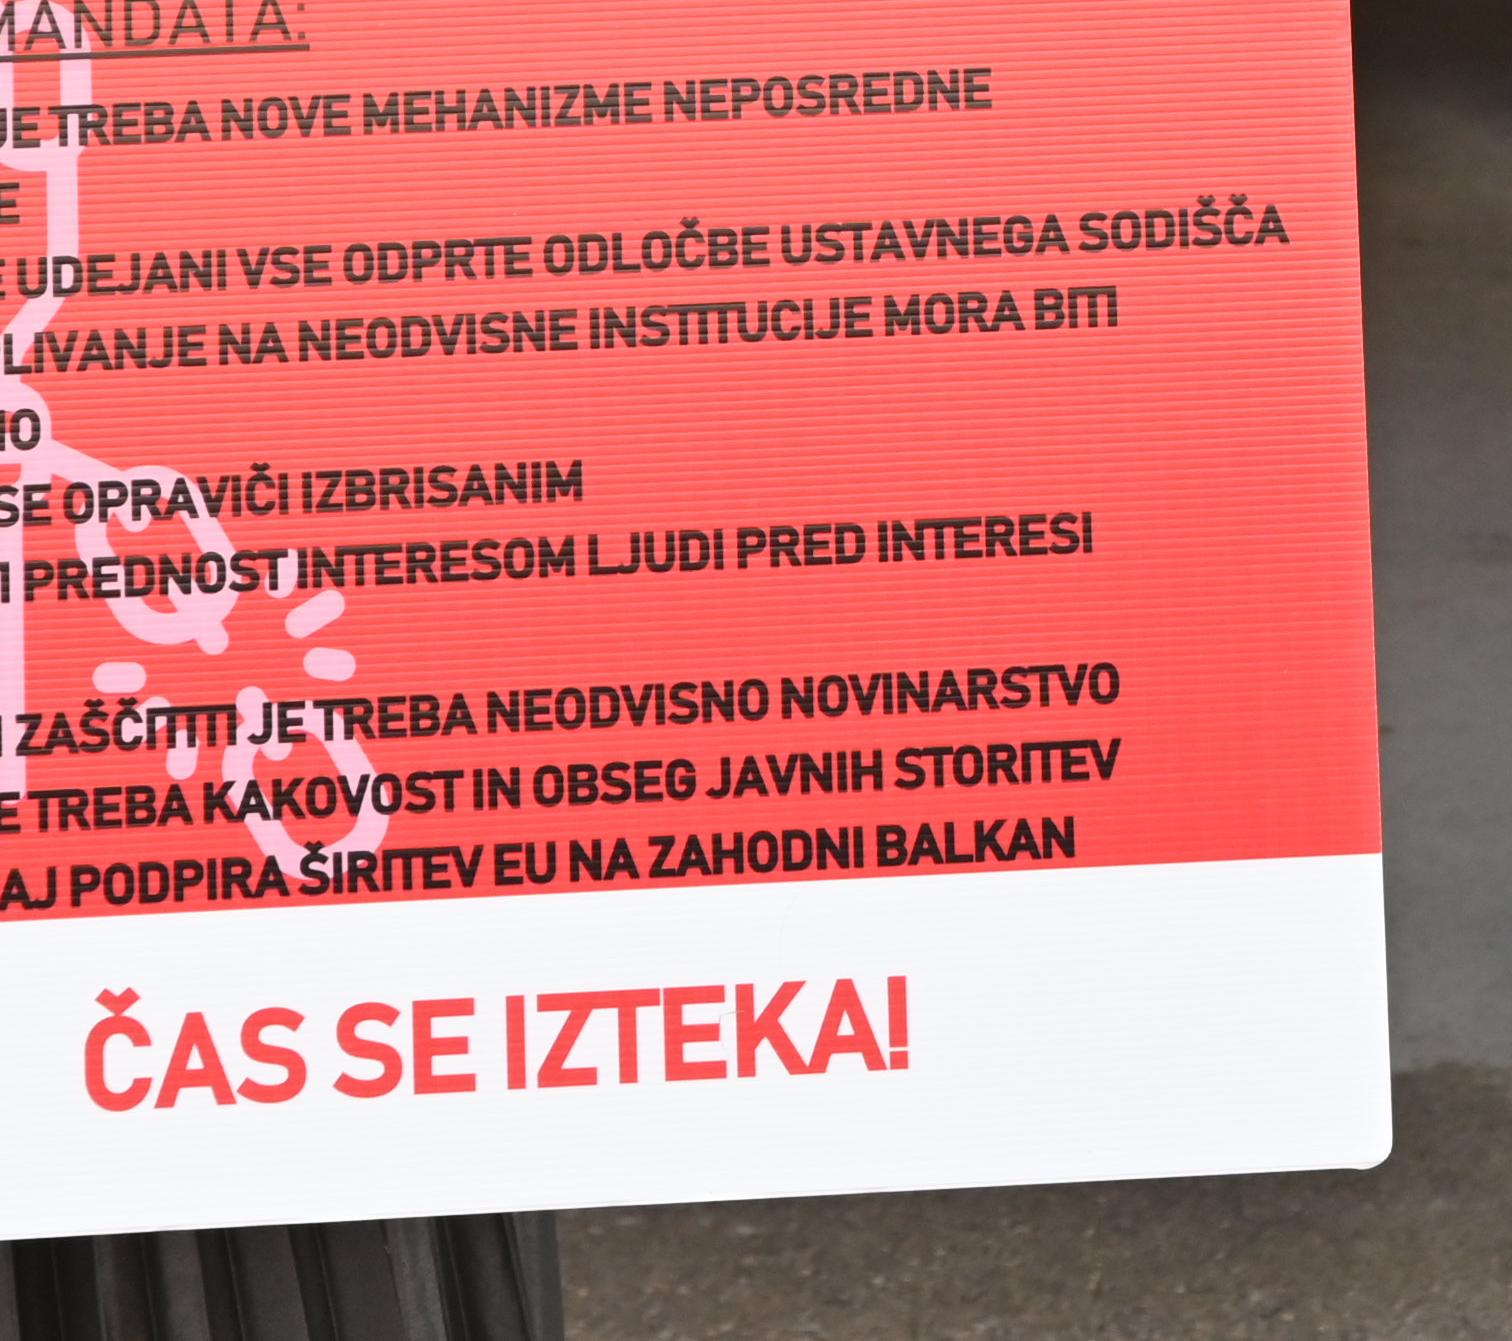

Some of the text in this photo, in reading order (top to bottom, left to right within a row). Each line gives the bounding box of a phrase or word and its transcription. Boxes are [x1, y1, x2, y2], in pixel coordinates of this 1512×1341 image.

[48, 101, 211, 146] TREBA
[222, 95, 351, 139] NOVE
[364, 83, 652, 134] MEHANIZME
[664, 68, 992, 121] NEPOSREDNE
[18, 250, 226, 298] UDEJANI
[238, 245, 332, 288] VSE
[344, 237, 533, 284] ODPRTE
[544, 219, 770, 275] ODLOČBE
[782, 215, 1069, 264] USTAVNEGA
[1080, 194, 1289, 252] SODIŠČA
[220, 323, 289, 365] NA
[299, 309, 578, 361] NEODVISNE
[590, 297, 873, 349] INSTITUCIJE
[885, 291, 1025, 336] MORA
[1035, 286, 1117, 329] BITI
[64, 463, 288, 524] OPRAVIČI
[303, 460, 582, 513] IZBRISANIM
[24, 549, 288, 601] PREDNOST
[298, 536, 575, 588] INTERESOM
[589, 529, 724, 575] LJUDI
[738, 523, 866, 568] PRED
[878, 512, 1092, 562] INTERESI
[16, 698, 237, 756] ZAŠČITITI
[248, 701, 306, 744] JE
[313, 693, 477, 741] TREBA
[488, 679, 769, 733] NEODVISNO
[782, 663, 1119, 718] NOVINARSTVO
[28, 784, 193, 832] TREBA
[204, 770, 464, 823] KAKOVOST
[474, 767, 520, 810] IN
[534, 759, 696, 807] OBSEG
[707, 750, 883, 798] JAVNIH
[896, 739, 1121, 789] STORITEV
[71, 856, 290, 907] PODPIRA
[299, 841, 483, 895] ŠIRITEV
[495, 842, 556, 885] EU
[570, 838, 640, 882] NA
[649, 827, 864, 878] ZAHODNI
[877, 816, 1075, 866] BALKAN
[85, 976, 908, 1111] ČAS SE IZTEKA!
